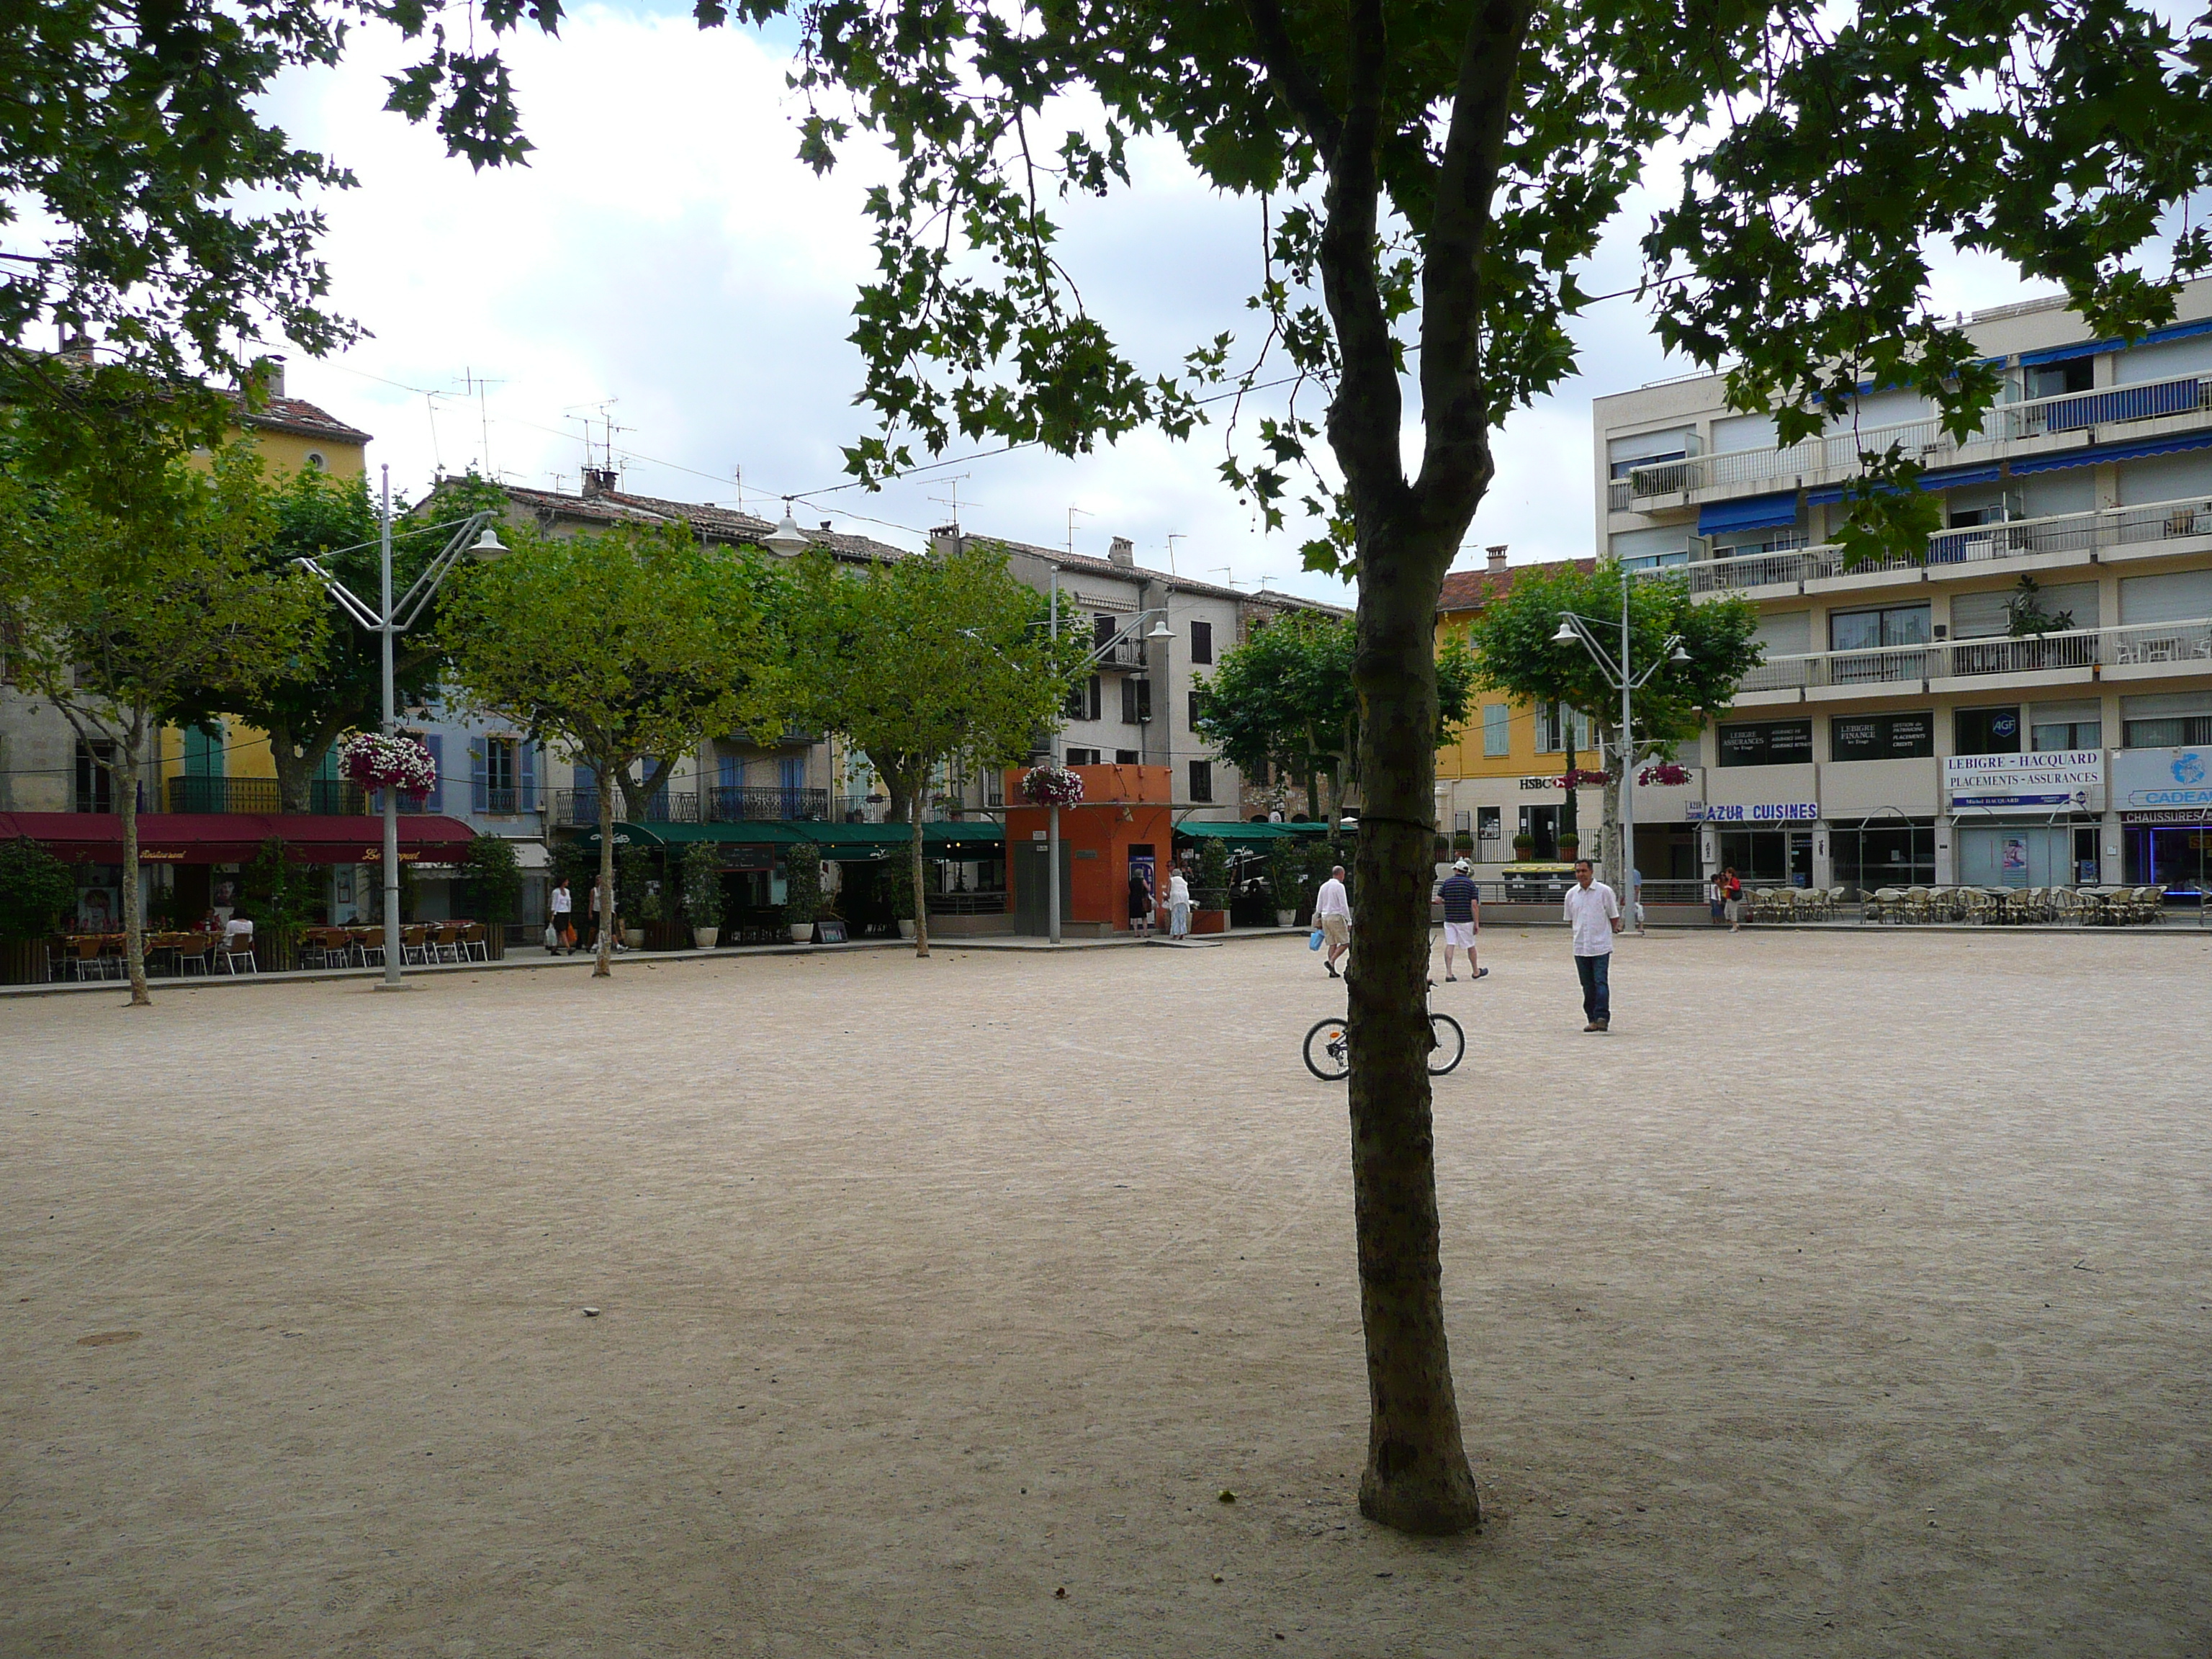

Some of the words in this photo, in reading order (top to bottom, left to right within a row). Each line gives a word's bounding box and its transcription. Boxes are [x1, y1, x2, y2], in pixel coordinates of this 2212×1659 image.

[1993, 720, 2015, 730] AGF
[1723, 737, 1764, 746] ASSURANCES
[1948, 757, 2005, 769] LEBIGRE
[2019, 753, 2098, 767] HACQUARD
[1519, 779, 1551, 790] HSBC
[1951, 775, 2018, 787] PLACEMENTS
[2027, 773, 2098, 785] ASSURANCES
[1707, 806, 1743, 820] AZUR
[1753, 804, 1817, 819] CUISINES
[2126, 811, 2201, 822] CHAUSSURES
[362, 848, 382, 860] Le
